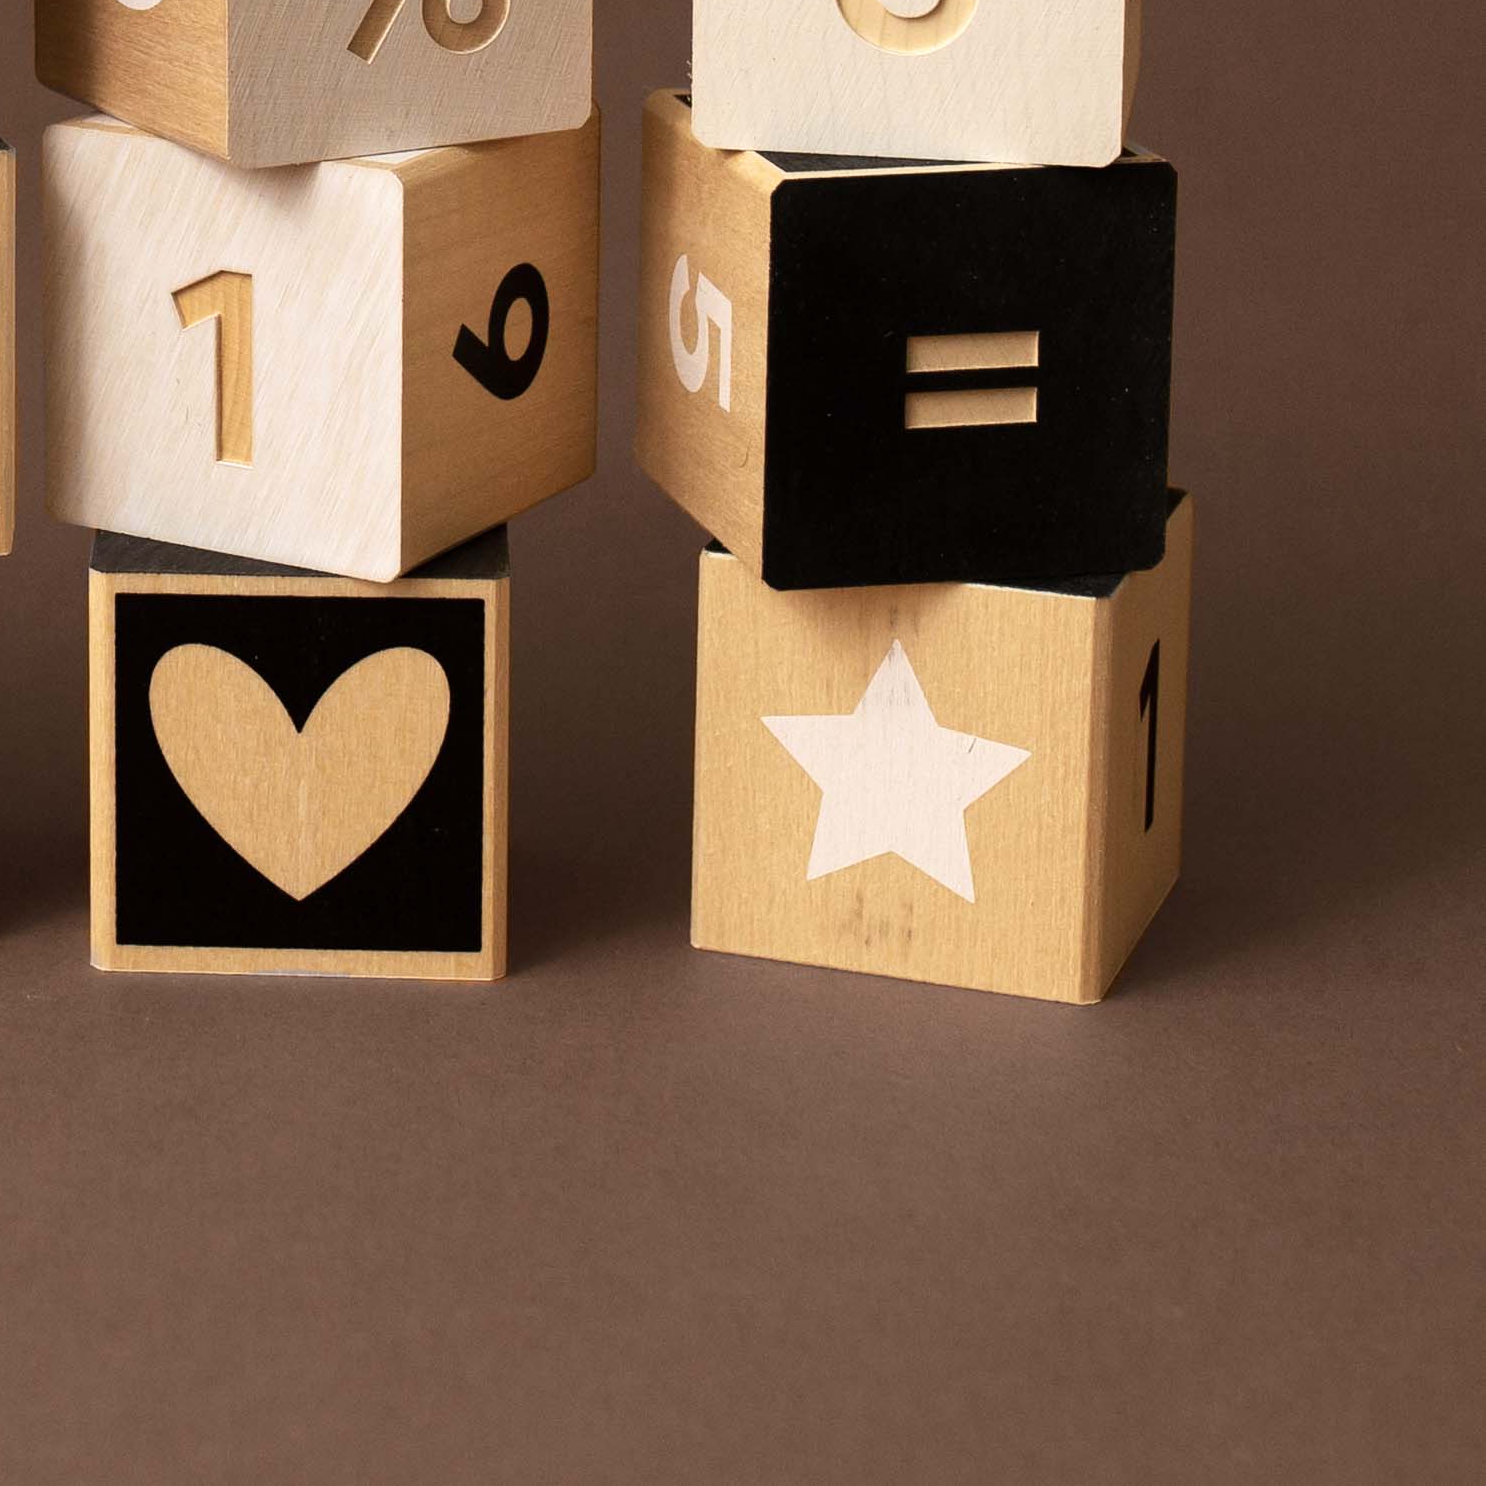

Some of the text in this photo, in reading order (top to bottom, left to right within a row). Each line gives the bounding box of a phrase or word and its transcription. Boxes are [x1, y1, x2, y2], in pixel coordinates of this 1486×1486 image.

[169, 268, 254, 469] 1
[667, 252, 733, 414] 5
[1139, 637, 1161, 834] 1
